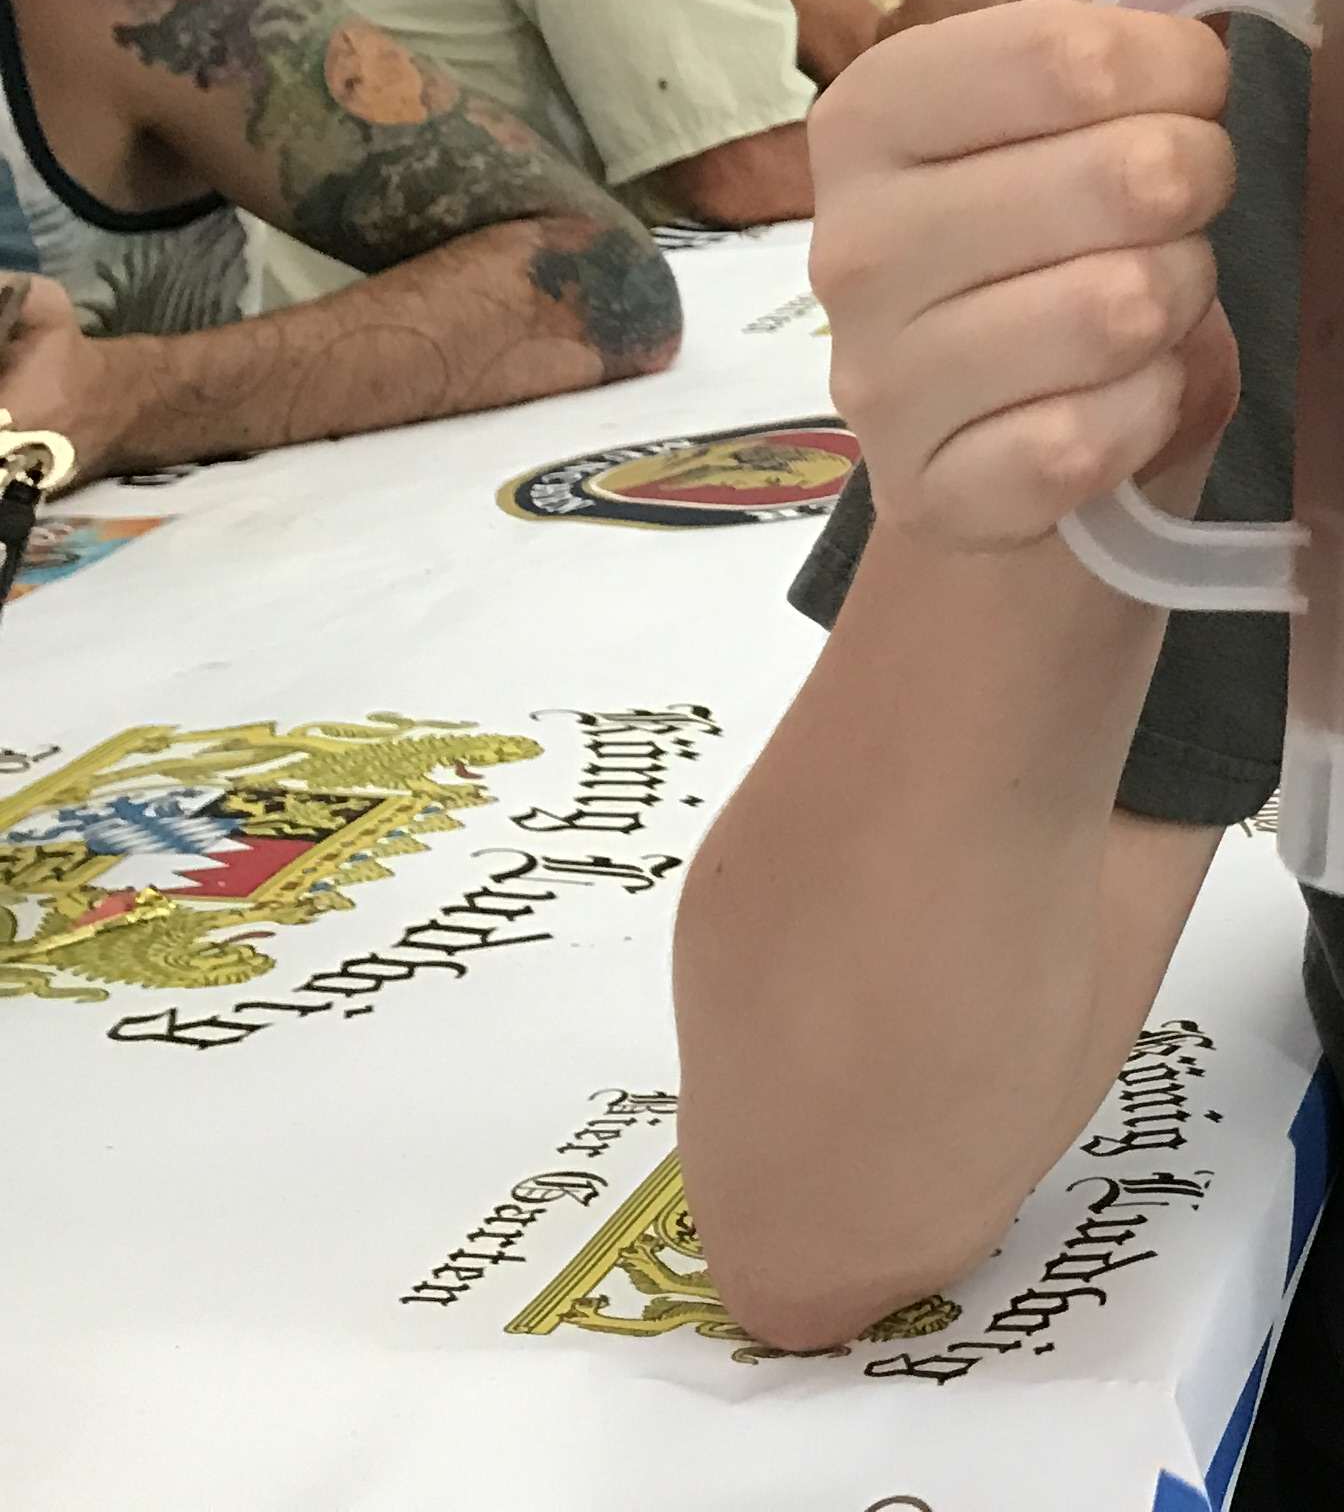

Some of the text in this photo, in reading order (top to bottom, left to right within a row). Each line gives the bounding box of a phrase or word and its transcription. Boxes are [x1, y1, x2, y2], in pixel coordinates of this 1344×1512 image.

[106, 703, 724, 1050] König Ludwig
[399, 1170, 609, 1307] Garten
[863, 1169, 1215, 1386] Ludwig
